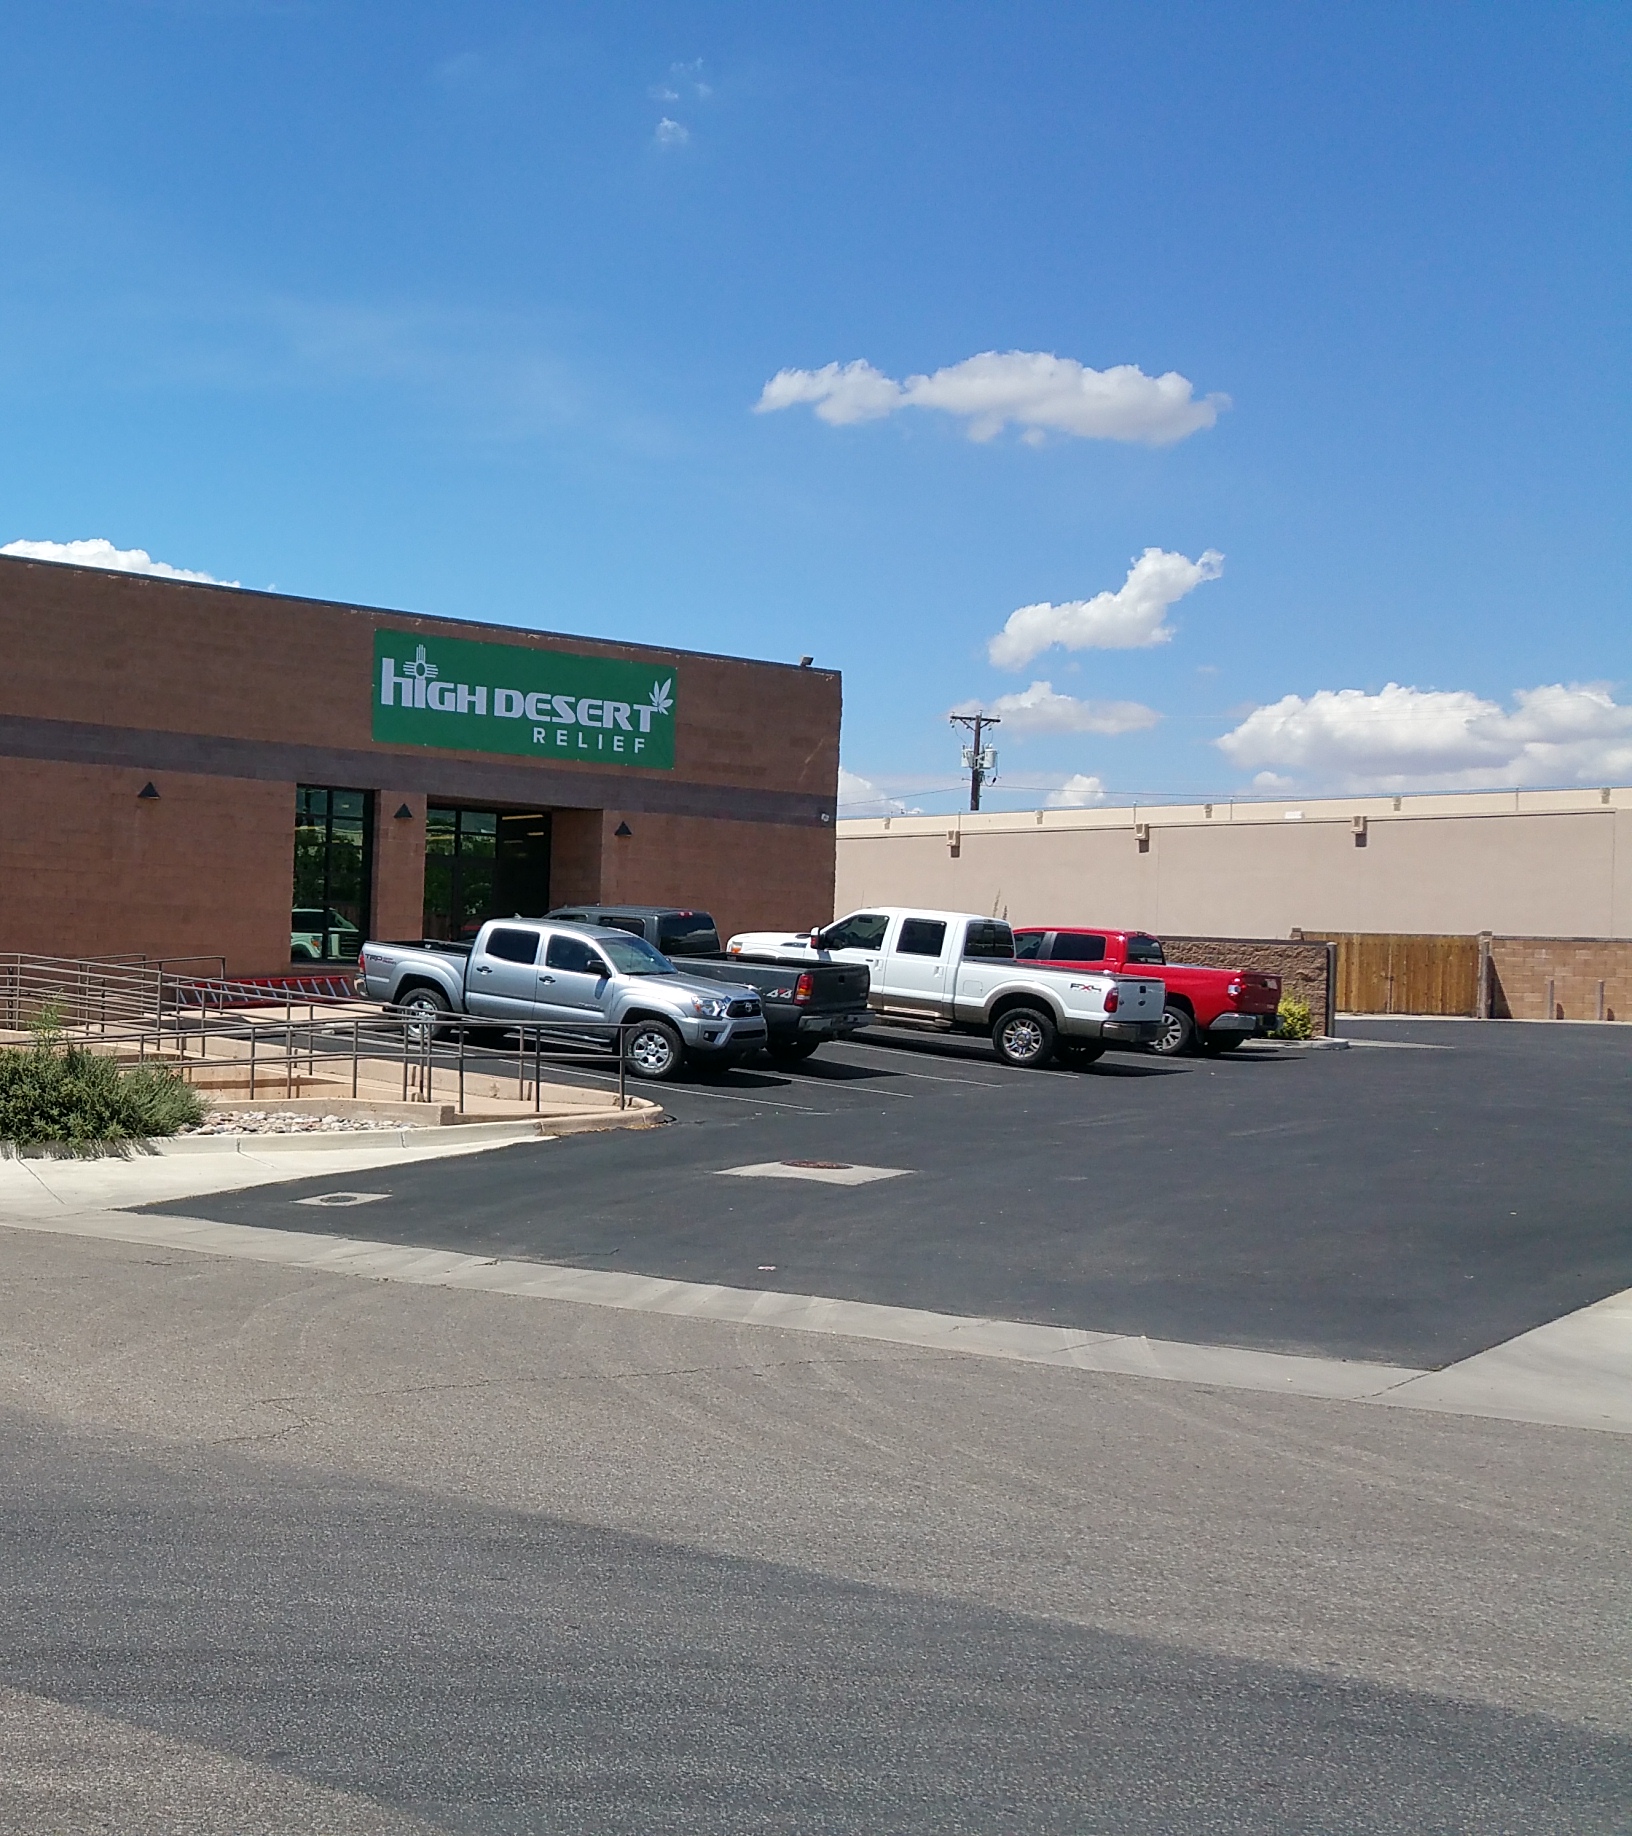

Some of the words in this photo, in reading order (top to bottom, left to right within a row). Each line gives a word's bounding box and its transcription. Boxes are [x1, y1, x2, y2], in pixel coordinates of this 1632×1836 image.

[493, 688, 660, 733] DESERT
[533, 727, 646, 754] RELIEF
[1070, 983, 1102, 992] FX4
